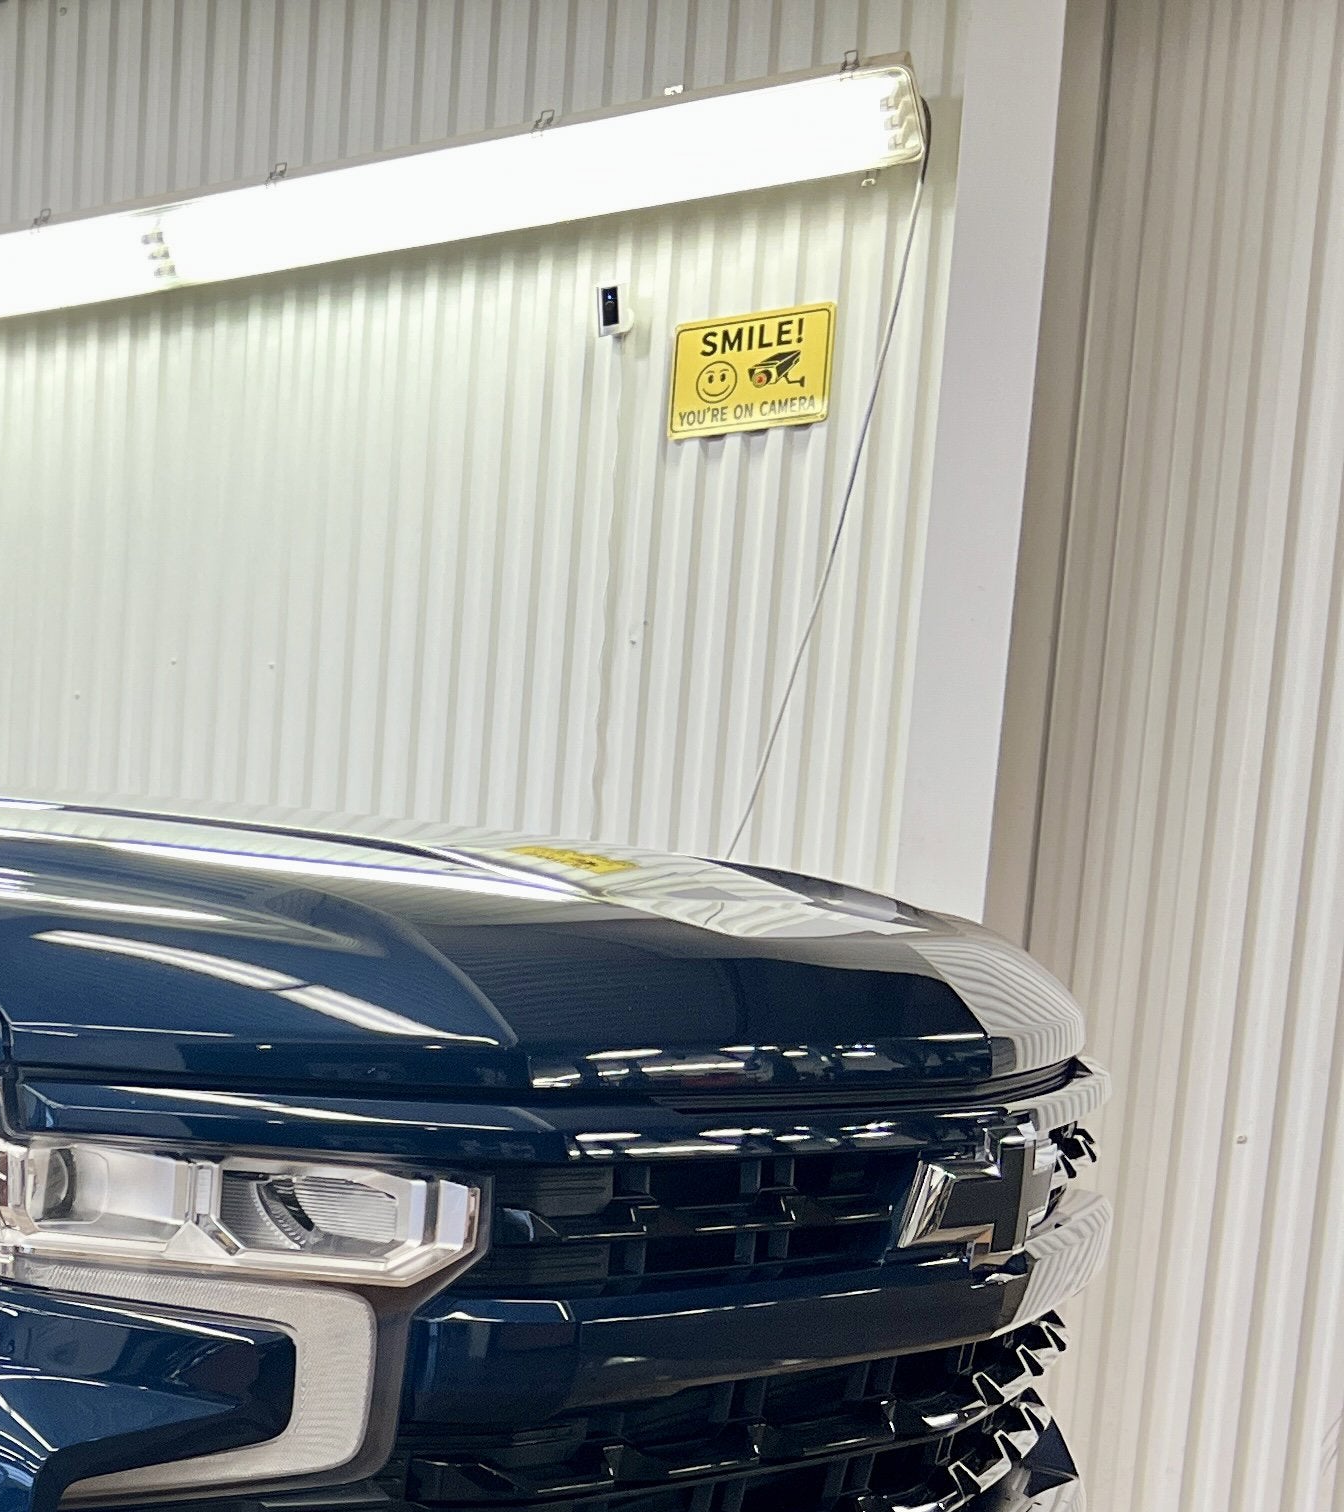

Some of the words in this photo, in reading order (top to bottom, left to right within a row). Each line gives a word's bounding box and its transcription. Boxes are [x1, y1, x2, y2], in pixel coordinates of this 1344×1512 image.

[700, 318, 804, 357] SMILE!
[678, 405, 728, 427] YOU'RE
[733, 403, 754, 420] ON
[759, 395, 815, 416] CAMERA
